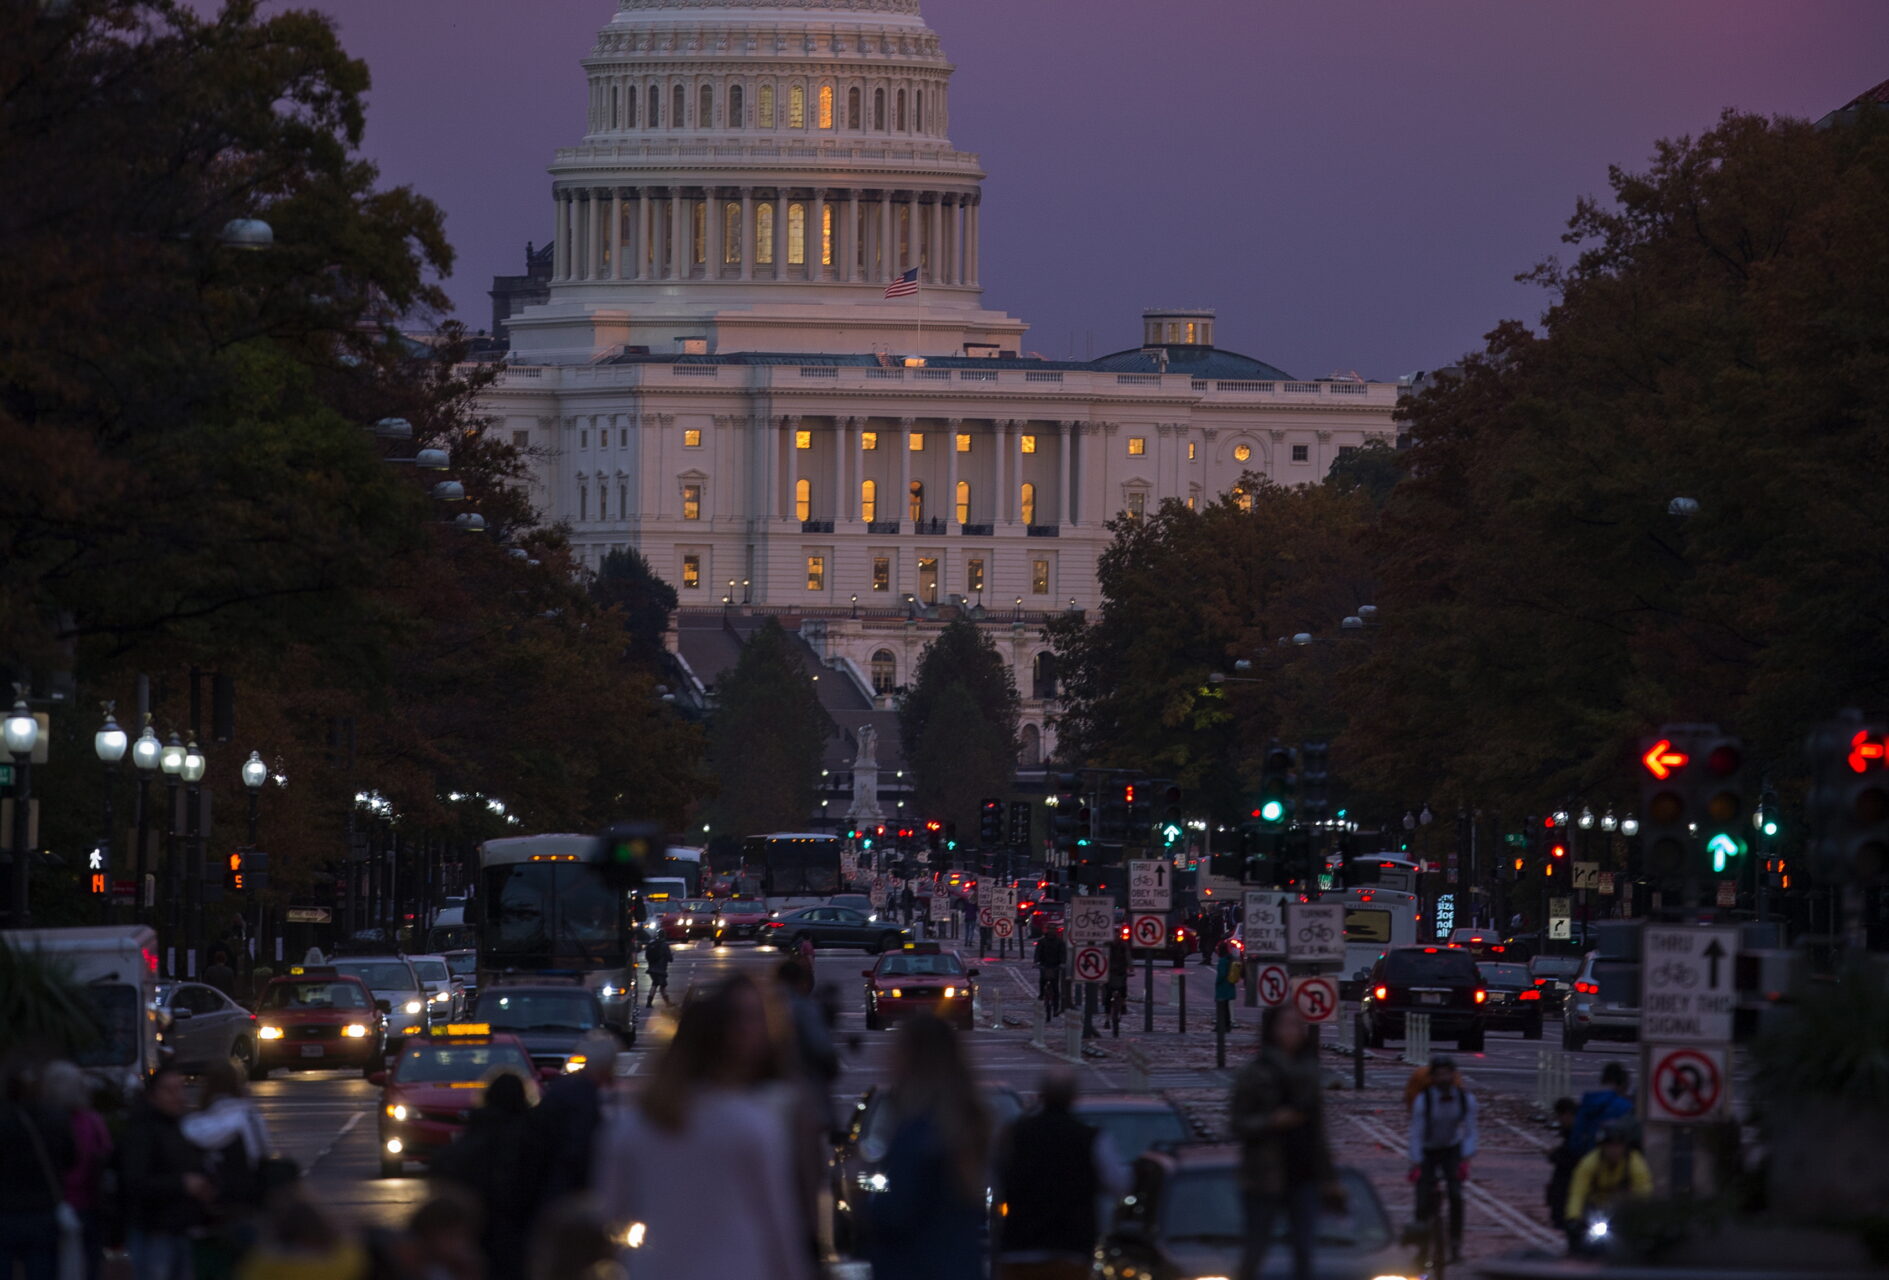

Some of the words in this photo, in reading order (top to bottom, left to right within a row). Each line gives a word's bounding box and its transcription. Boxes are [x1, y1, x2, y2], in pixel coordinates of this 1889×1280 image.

[1132, 863, 1151, 871] THRU
[1131, 889, 1150, 897] OBEY
[1153, 889, 1169, 897] THIS
[1132, 899, 1156, 907] SIGNAL
[1651, 933, 1694, 953] THRU
[1647, 1016, 1702, 1035] SIGNAL
